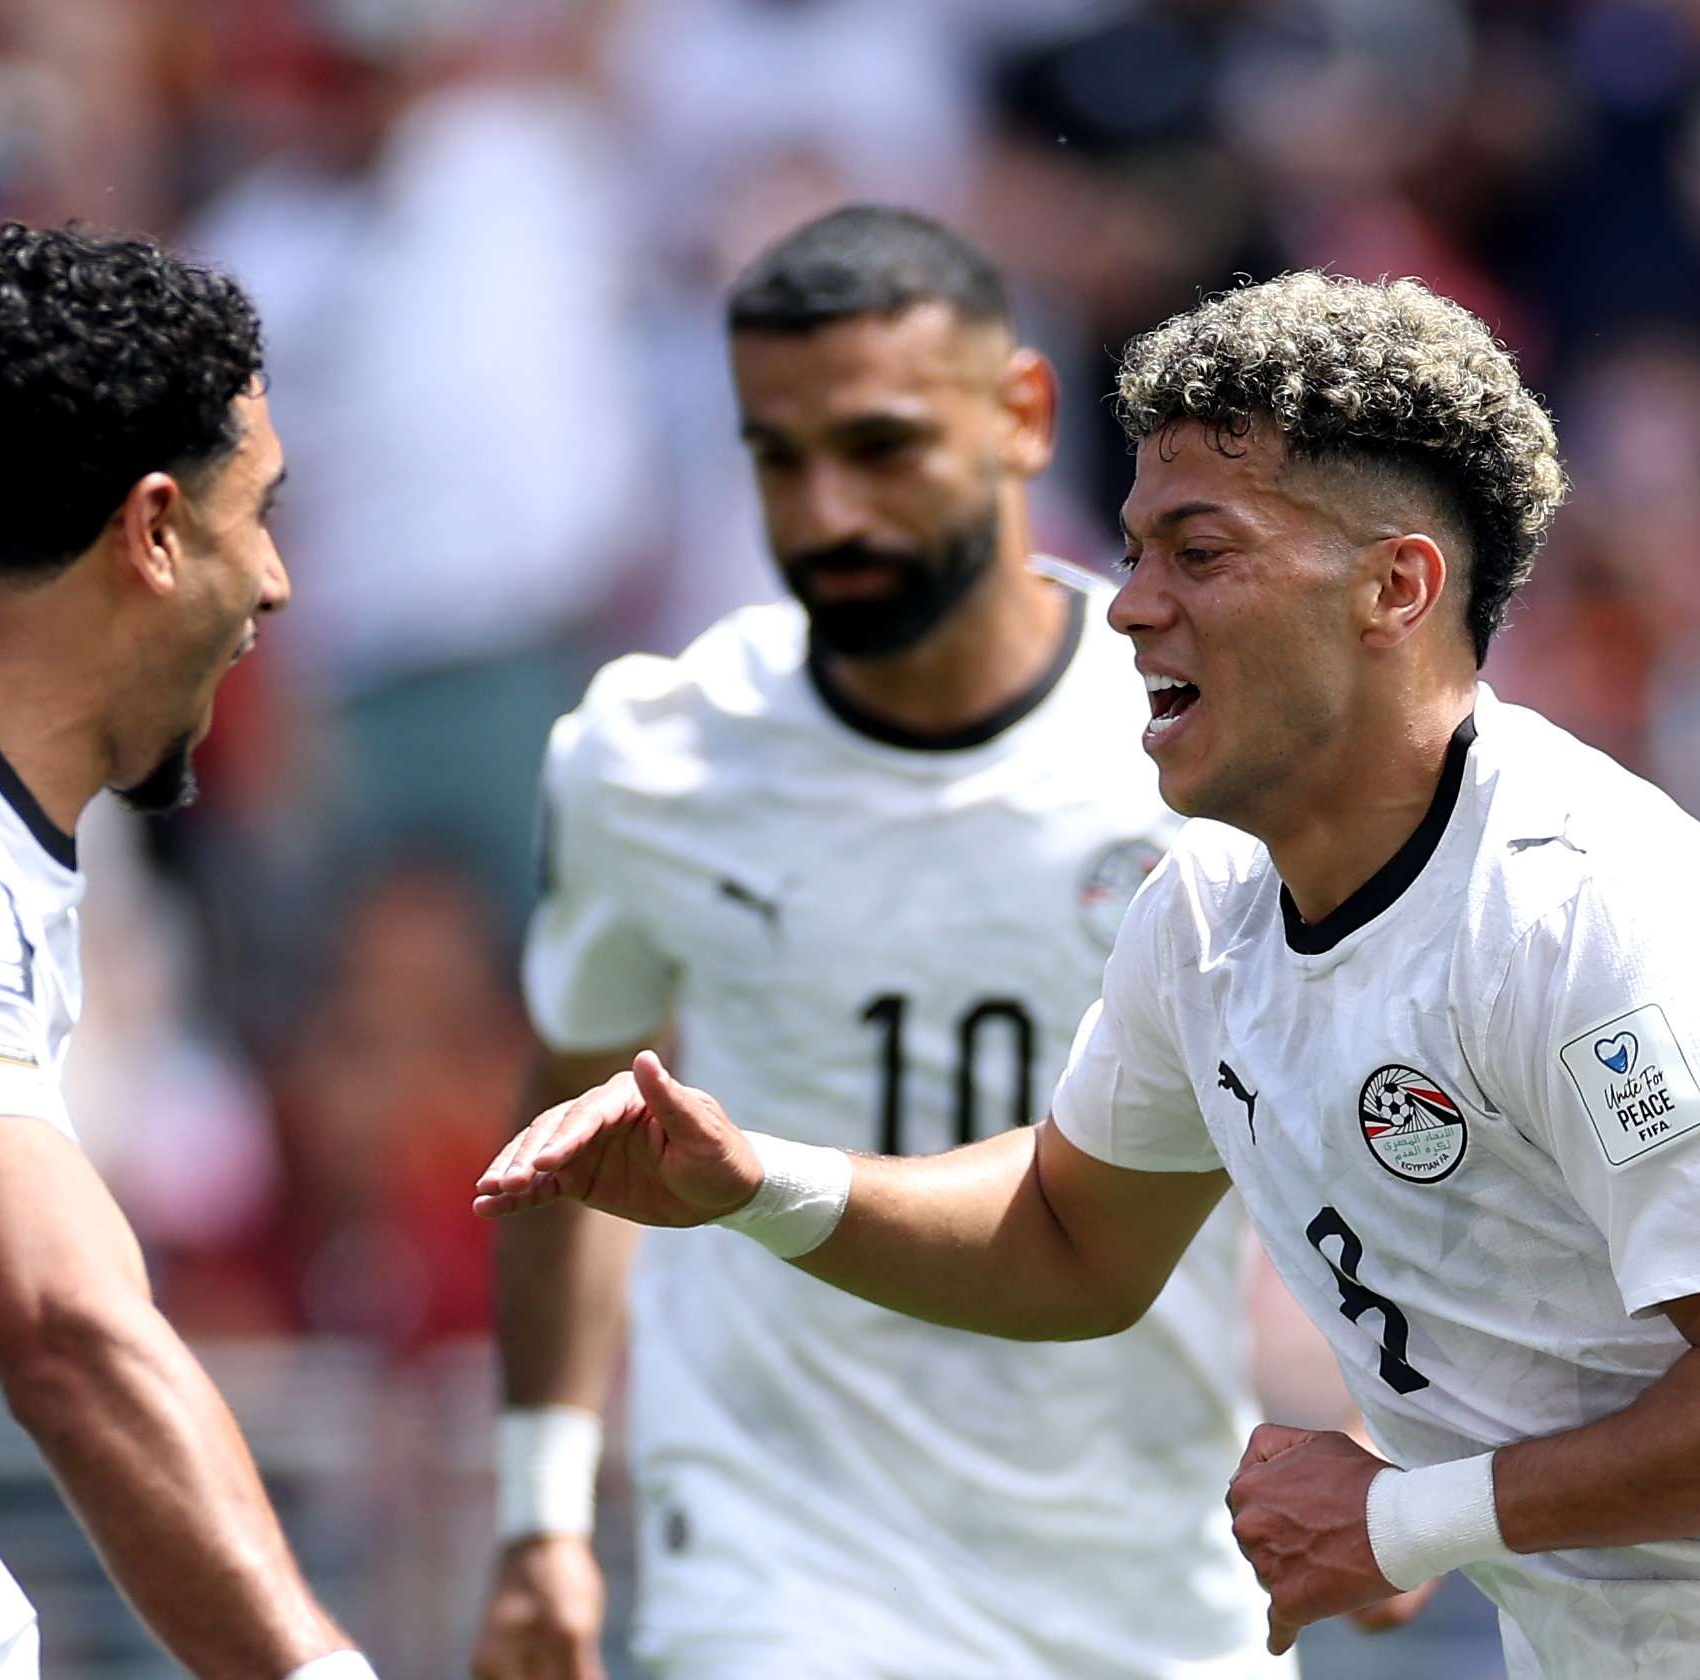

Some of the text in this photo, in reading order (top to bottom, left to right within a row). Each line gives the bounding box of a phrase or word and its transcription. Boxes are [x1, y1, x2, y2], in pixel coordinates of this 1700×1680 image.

[860, 992, 1036, 1157] 10
[1604, 1065, 1664, 1110] Unite For
[1617, 1088, 1675, 1132] PEACE
[1638, 1120, 1670, 1142] FIFA
[1401, 1153, 1450, 1172] EGYPTIAN FA
